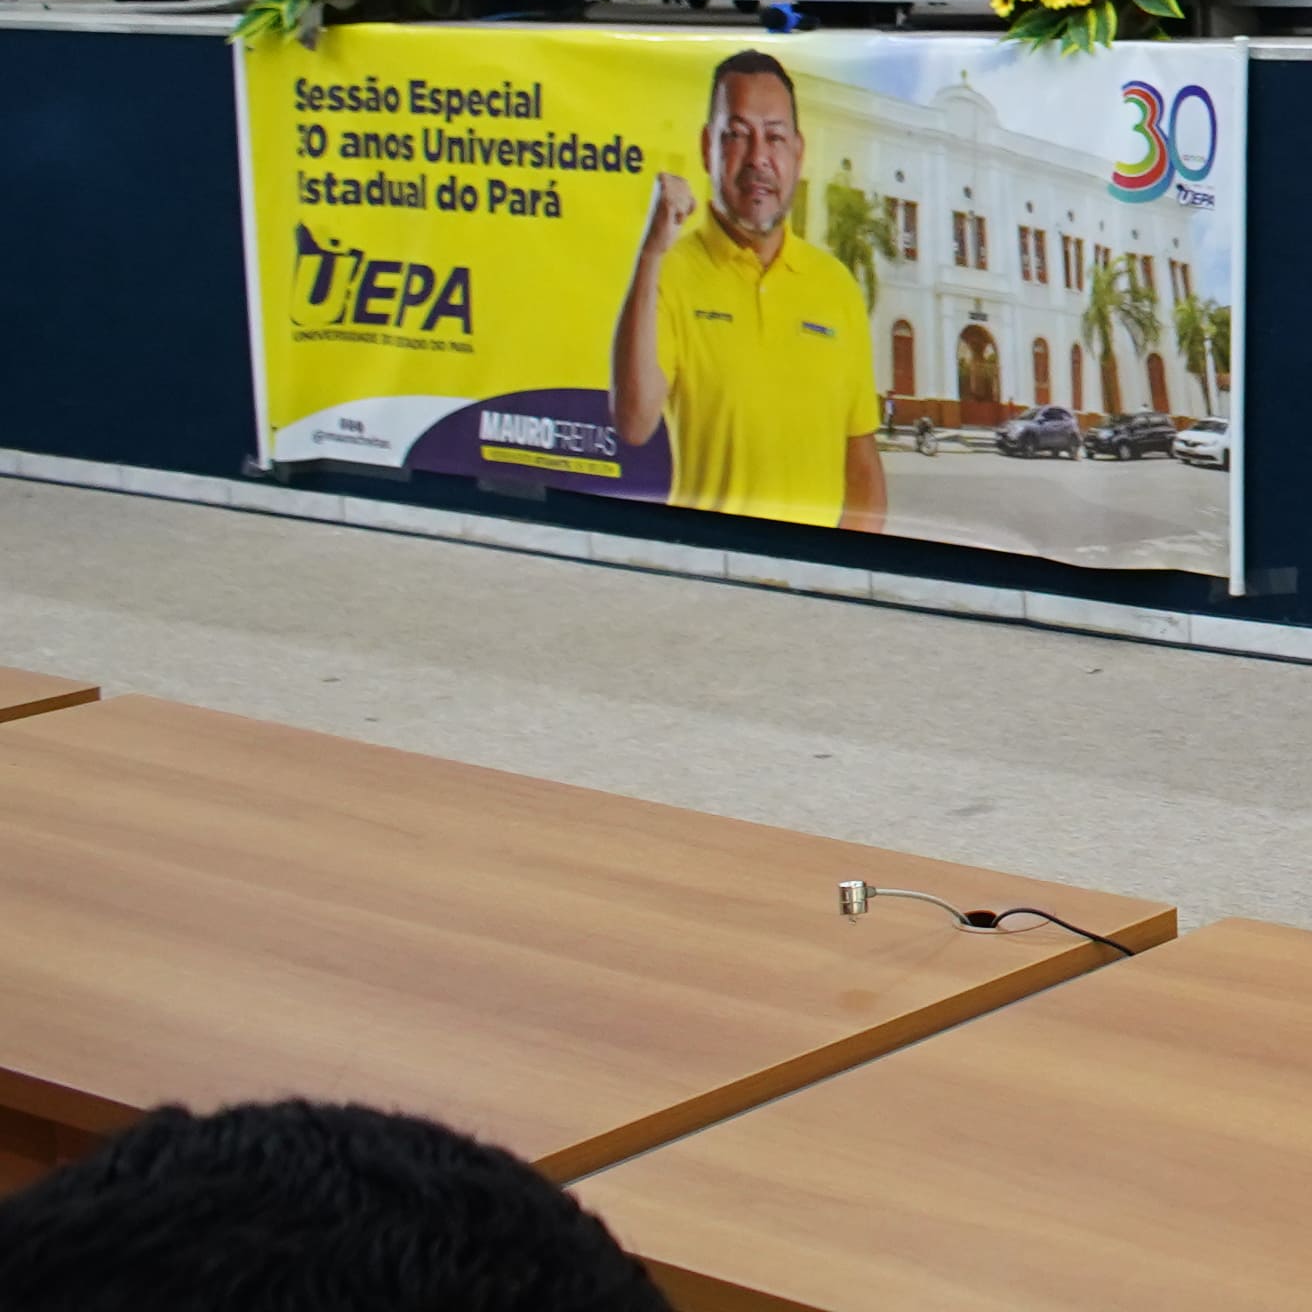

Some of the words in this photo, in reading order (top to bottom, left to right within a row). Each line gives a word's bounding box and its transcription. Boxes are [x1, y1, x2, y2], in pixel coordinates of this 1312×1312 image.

[409, 79, 542, 123] Especial
[340, 131, 414, 161] anos
[423, 127, 643, 173] Universidade
[437, 175, 478, 212] do
[488, 179, 562, 218] Pará
